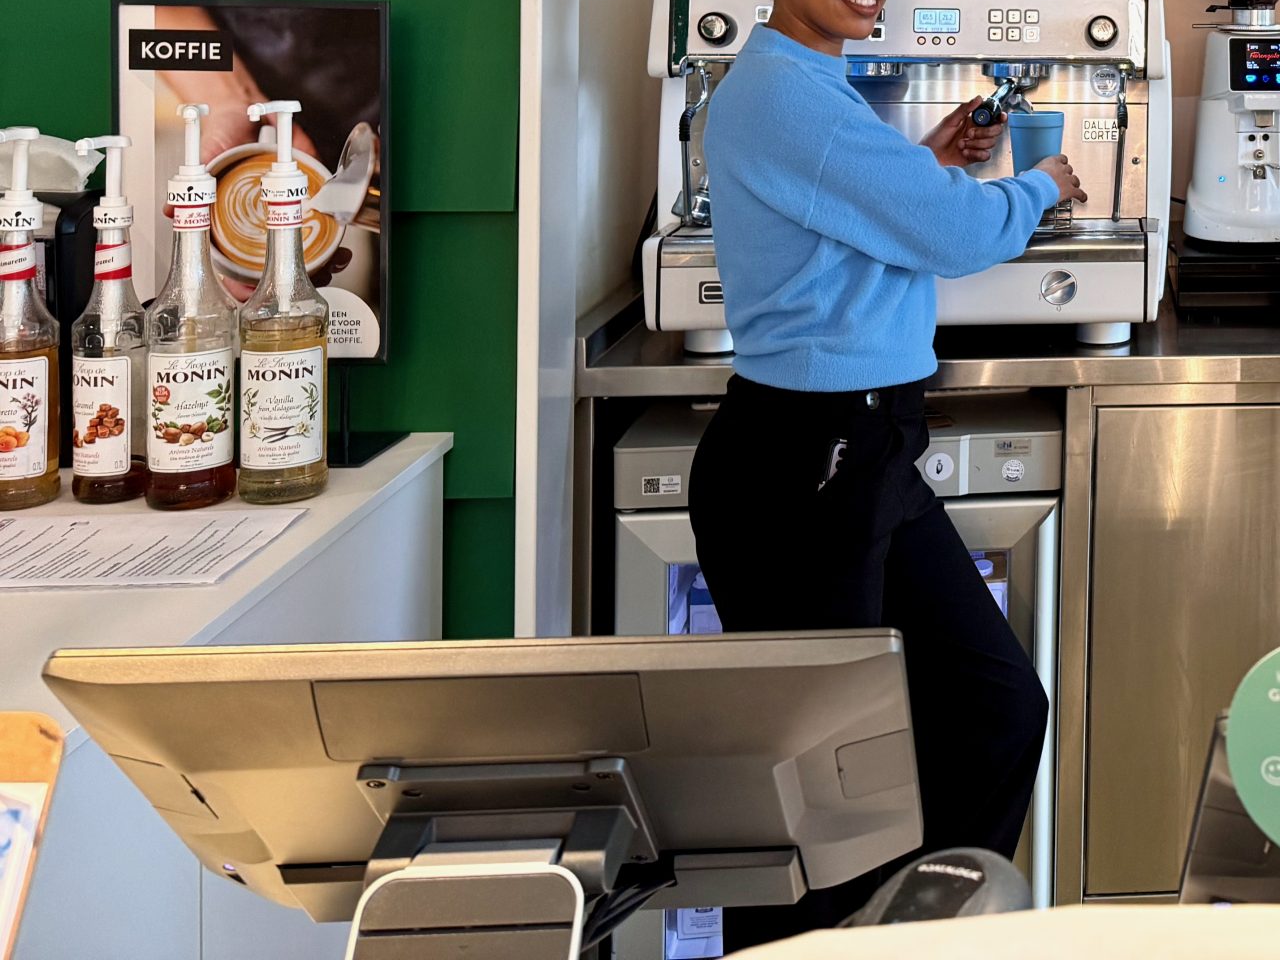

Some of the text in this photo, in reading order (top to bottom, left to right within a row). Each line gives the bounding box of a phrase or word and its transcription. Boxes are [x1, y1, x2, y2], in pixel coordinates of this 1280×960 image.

[141, 41, 221, 60] KOFFIE
[1084, 120, 1118, 130] DALLA
[1083, 131, 1118, 141] CORTE
[338, 319, 361, 327] VOOR
[330, 328, 359, 336] GENIET
[156, 366, 226, 384] MONIN
[247, 365, 314, 382] MONIN
